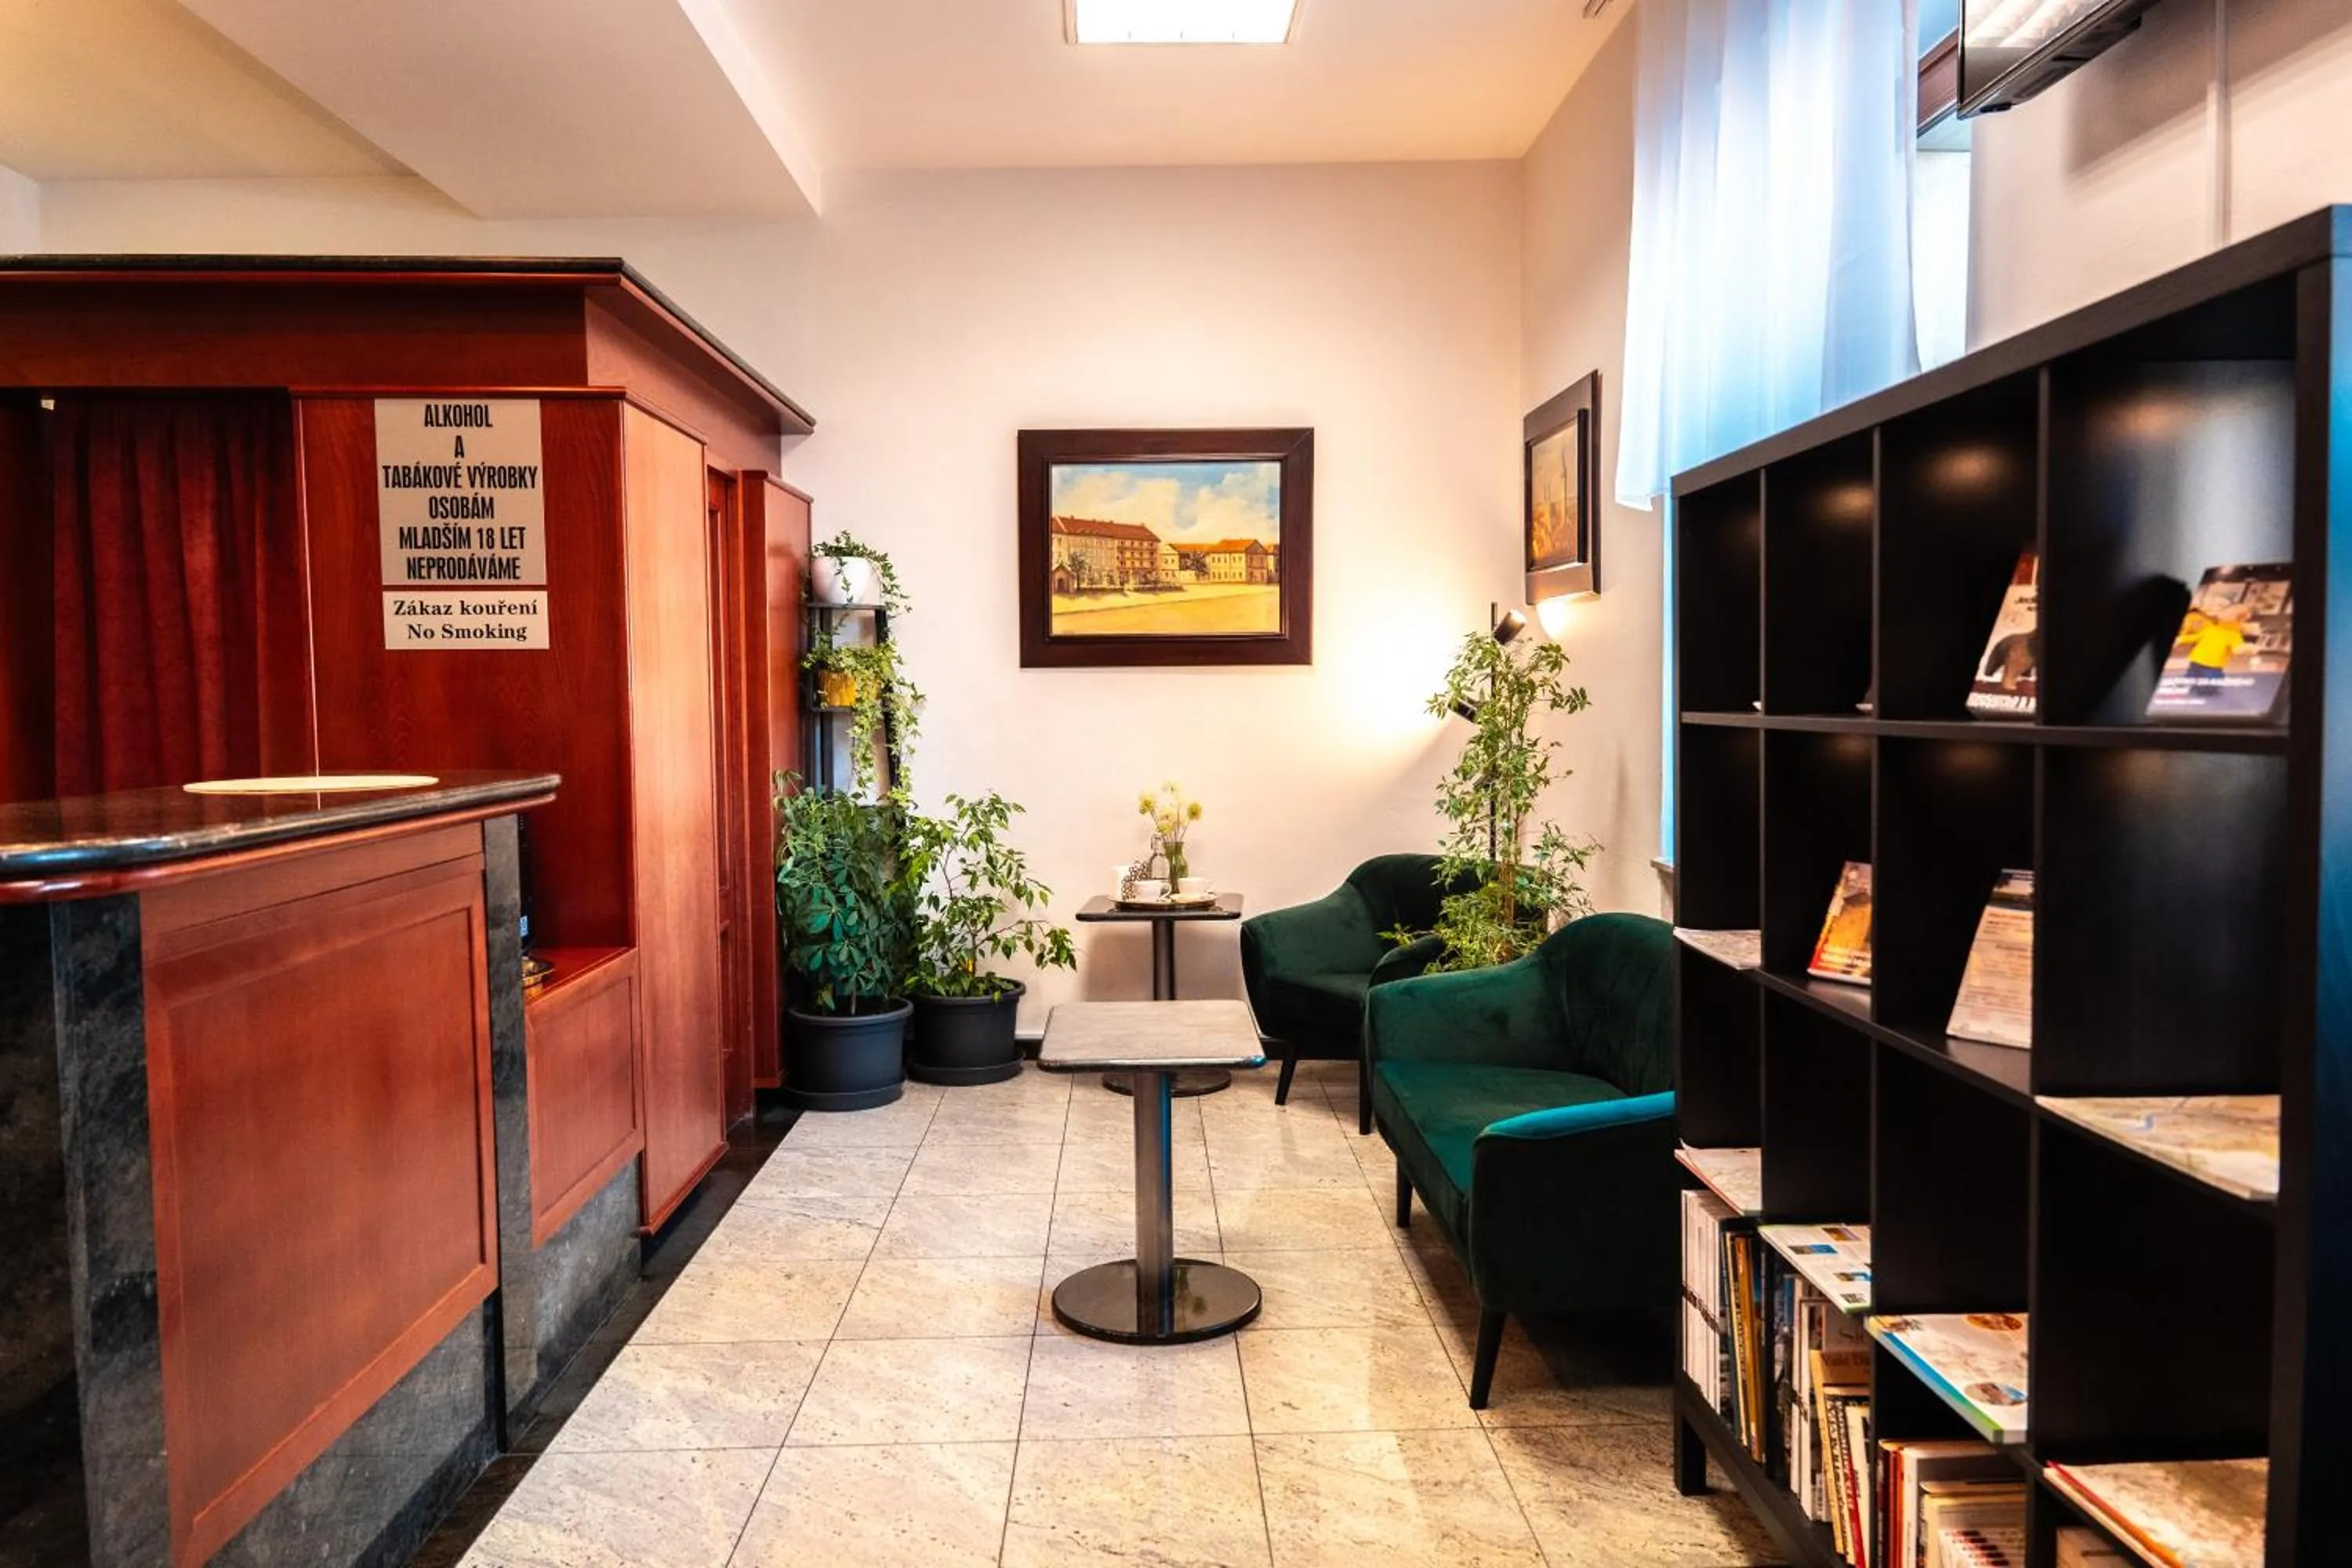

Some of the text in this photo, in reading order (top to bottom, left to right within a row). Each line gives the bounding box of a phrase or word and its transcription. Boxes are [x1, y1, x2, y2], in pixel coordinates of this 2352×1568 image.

[424, 405, 493, 427] ALKOHOL
[454, 435, 465, 458] A
[383, 462, 538, 488] TABÁKOVÉ VÝROBKY
[429, 492, 495, 519] OSOBÁM
[399, 523, 526, 550] MLADŠÍM 18 LET
[407, 554, 521, 579] NEPRODÁVÁME
[394, 599, 538, 615] Zákaz kouření
[408, 624, 528, 642] No Smoking
